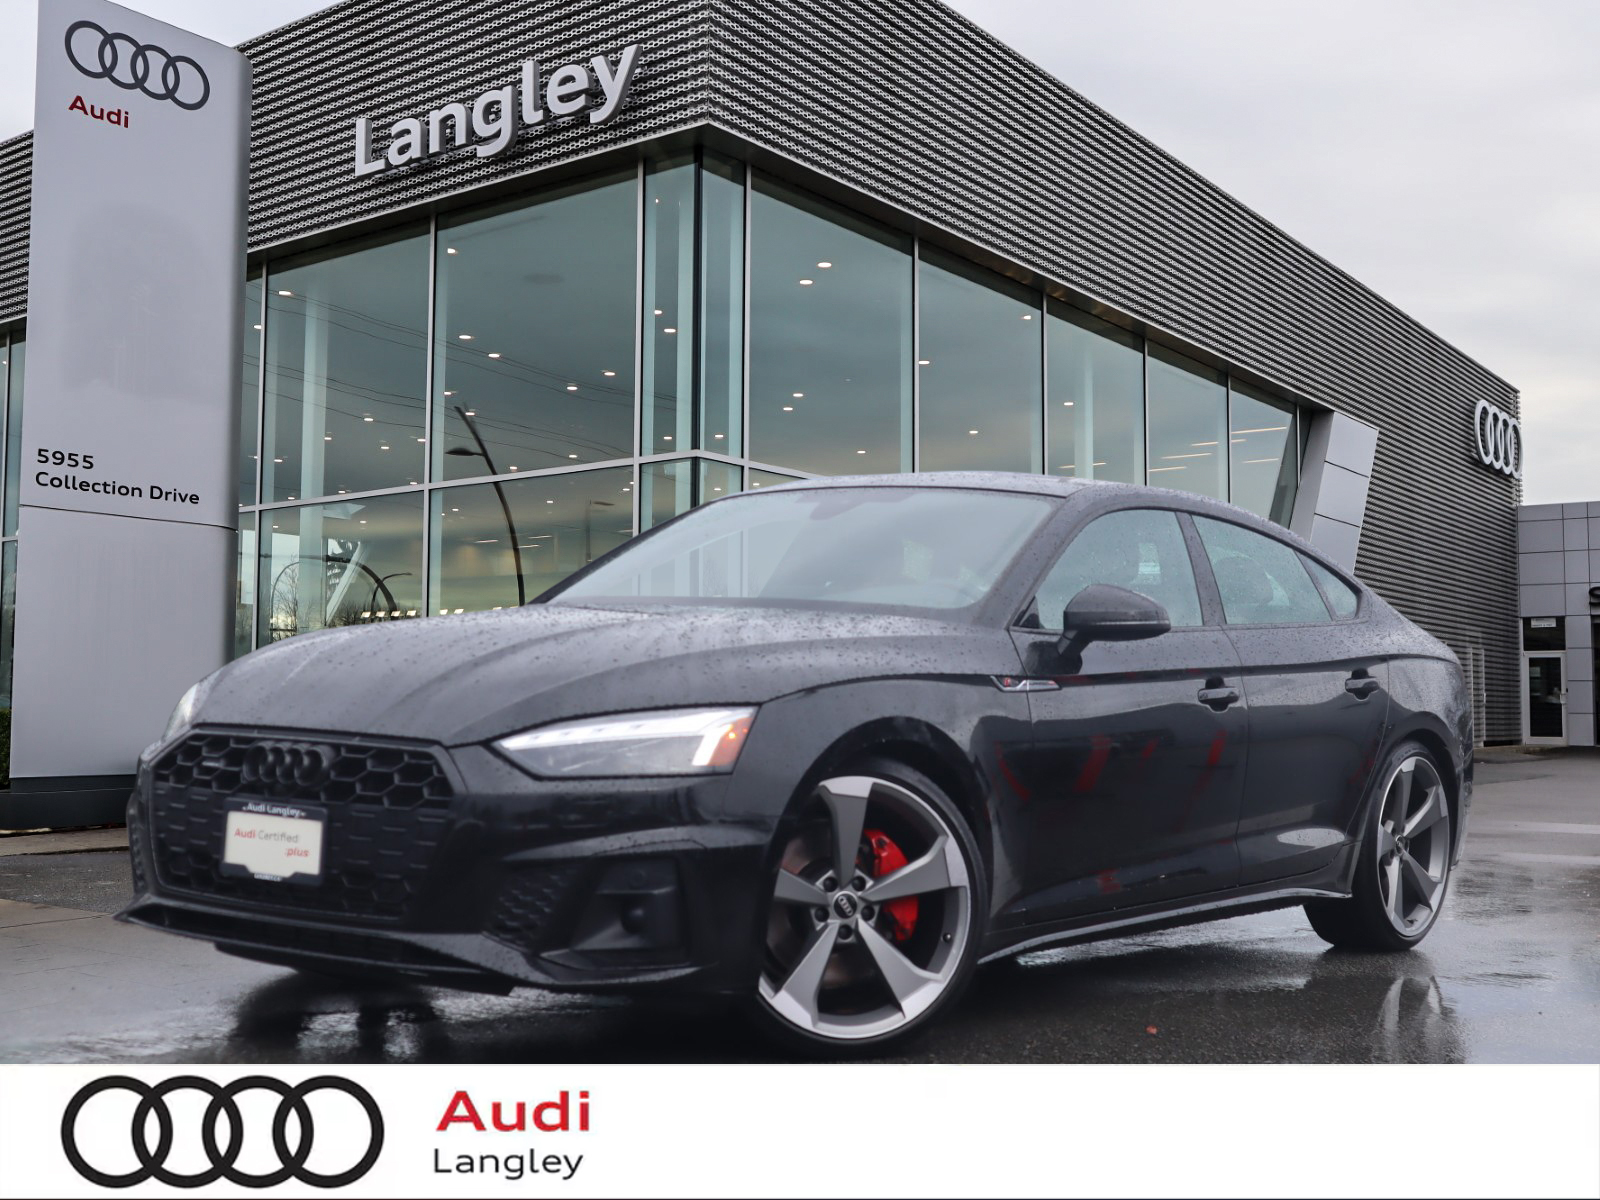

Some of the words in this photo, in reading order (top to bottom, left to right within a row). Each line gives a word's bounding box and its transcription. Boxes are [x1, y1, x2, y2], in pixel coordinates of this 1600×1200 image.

[68, 94, 129, 129] Audi
[354, 44, 643, 177] Langley
[36, 448, 94, 470] 5955
[35, 471, 142, 498] Collection
[149, 485, 200, 505] Drive
[247, 802, 265, 812] Audi
[267, 804, 300, 818] Langley
[234, 828, 256, 838] Audi
[258, 830, 298, 843] Certified
